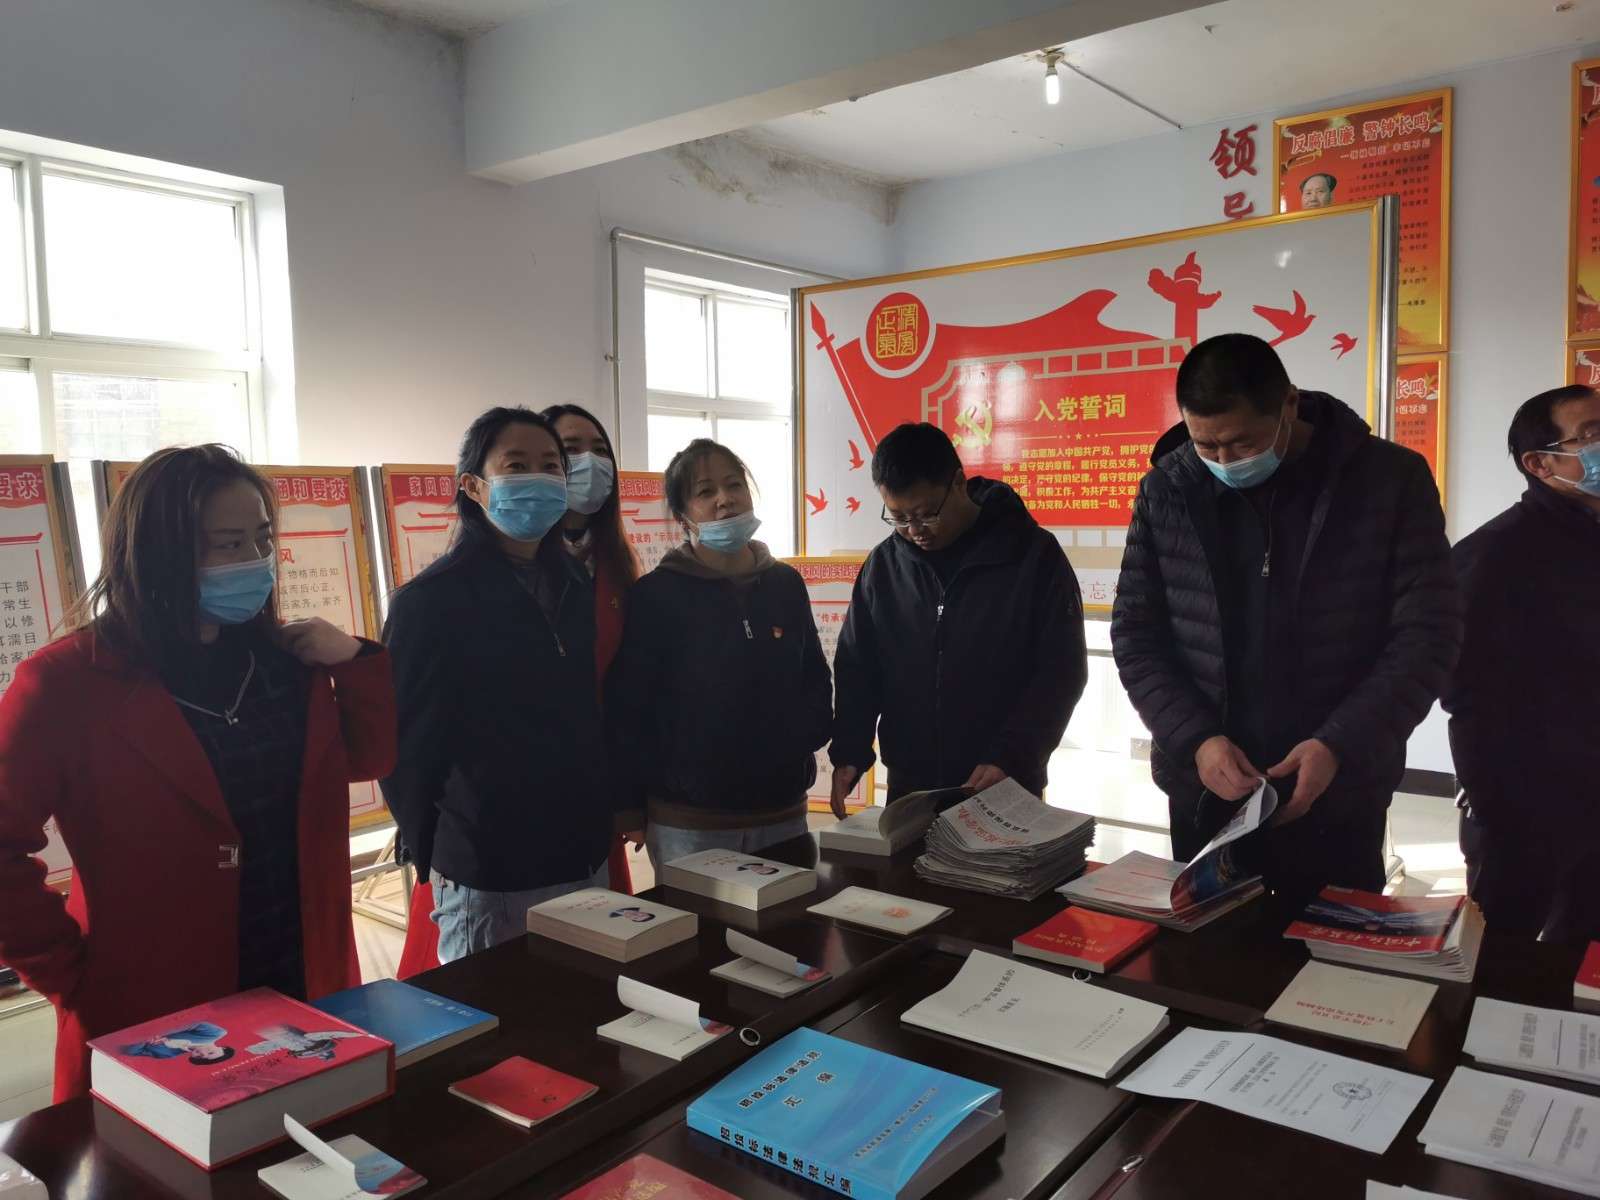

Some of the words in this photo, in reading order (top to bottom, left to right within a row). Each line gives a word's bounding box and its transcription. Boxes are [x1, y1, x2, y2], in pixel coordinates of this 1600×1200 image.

[1291, 126, 1355, 155] 反腐倡廉
[1363, 112, 1431, 142] 警钟长鸣
[1035, 394, 1126, 421] 入党誓词
